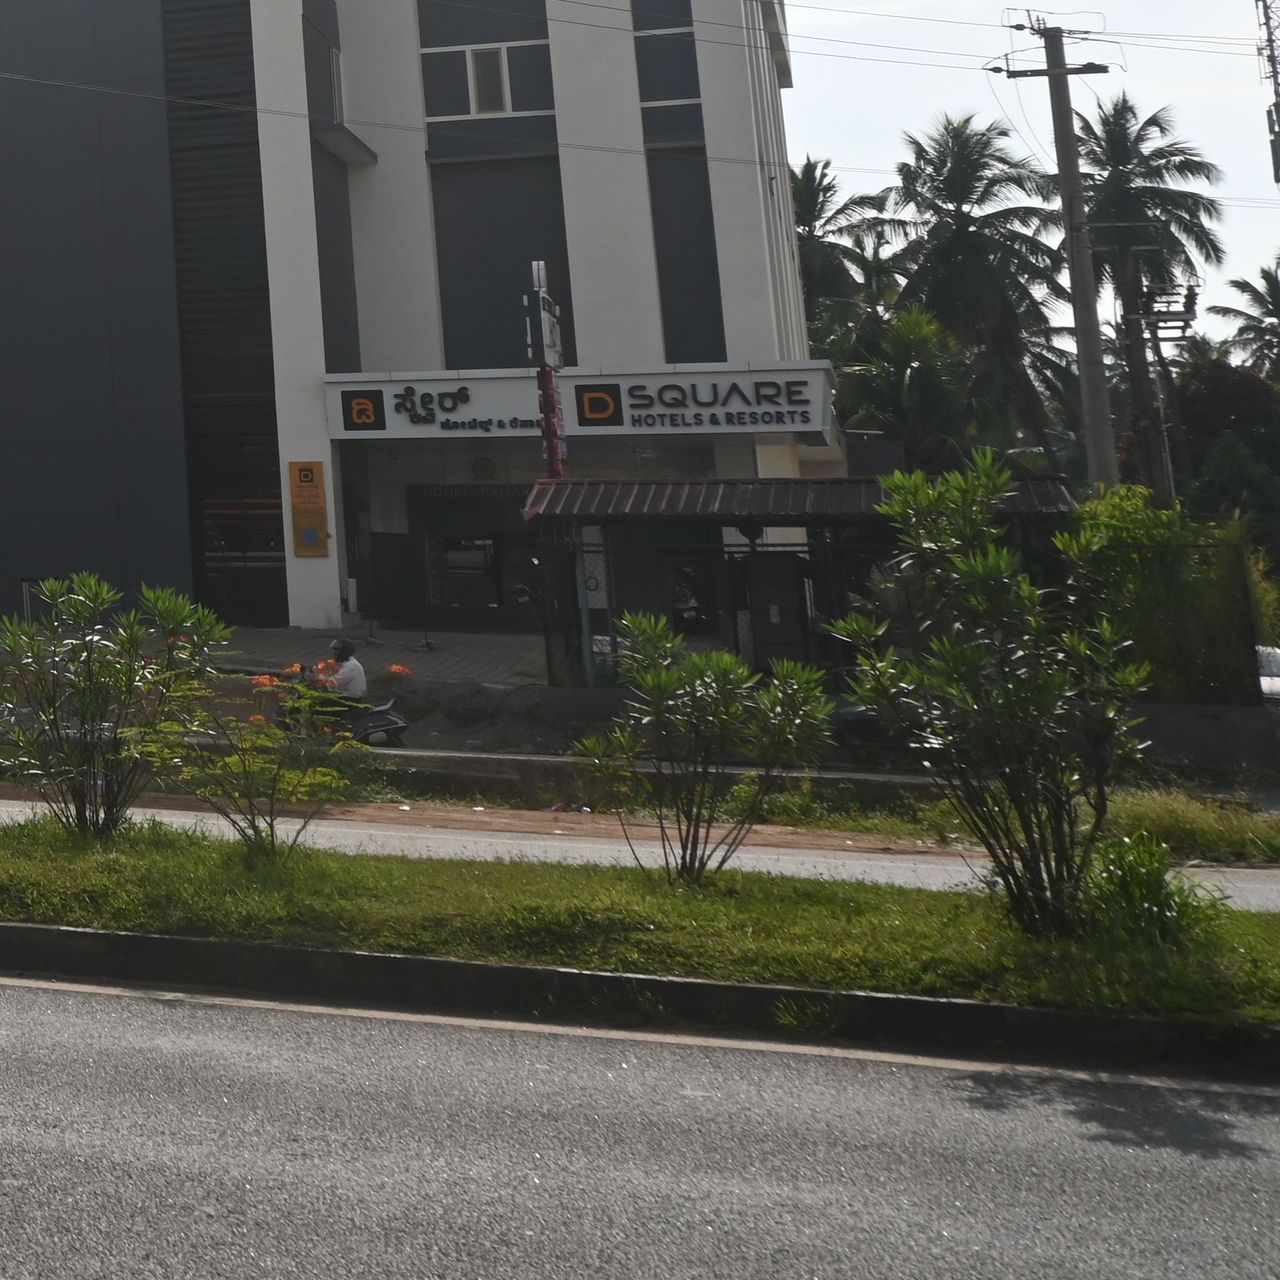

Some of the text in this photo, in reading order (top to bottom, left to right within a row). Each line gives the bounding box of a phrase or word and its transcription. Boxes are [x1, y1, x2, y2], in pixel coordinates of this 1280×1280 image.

[582, 381, 810, 419] D SQUARE
[631, 410, 811, 427] HOTELS & RESORTS
